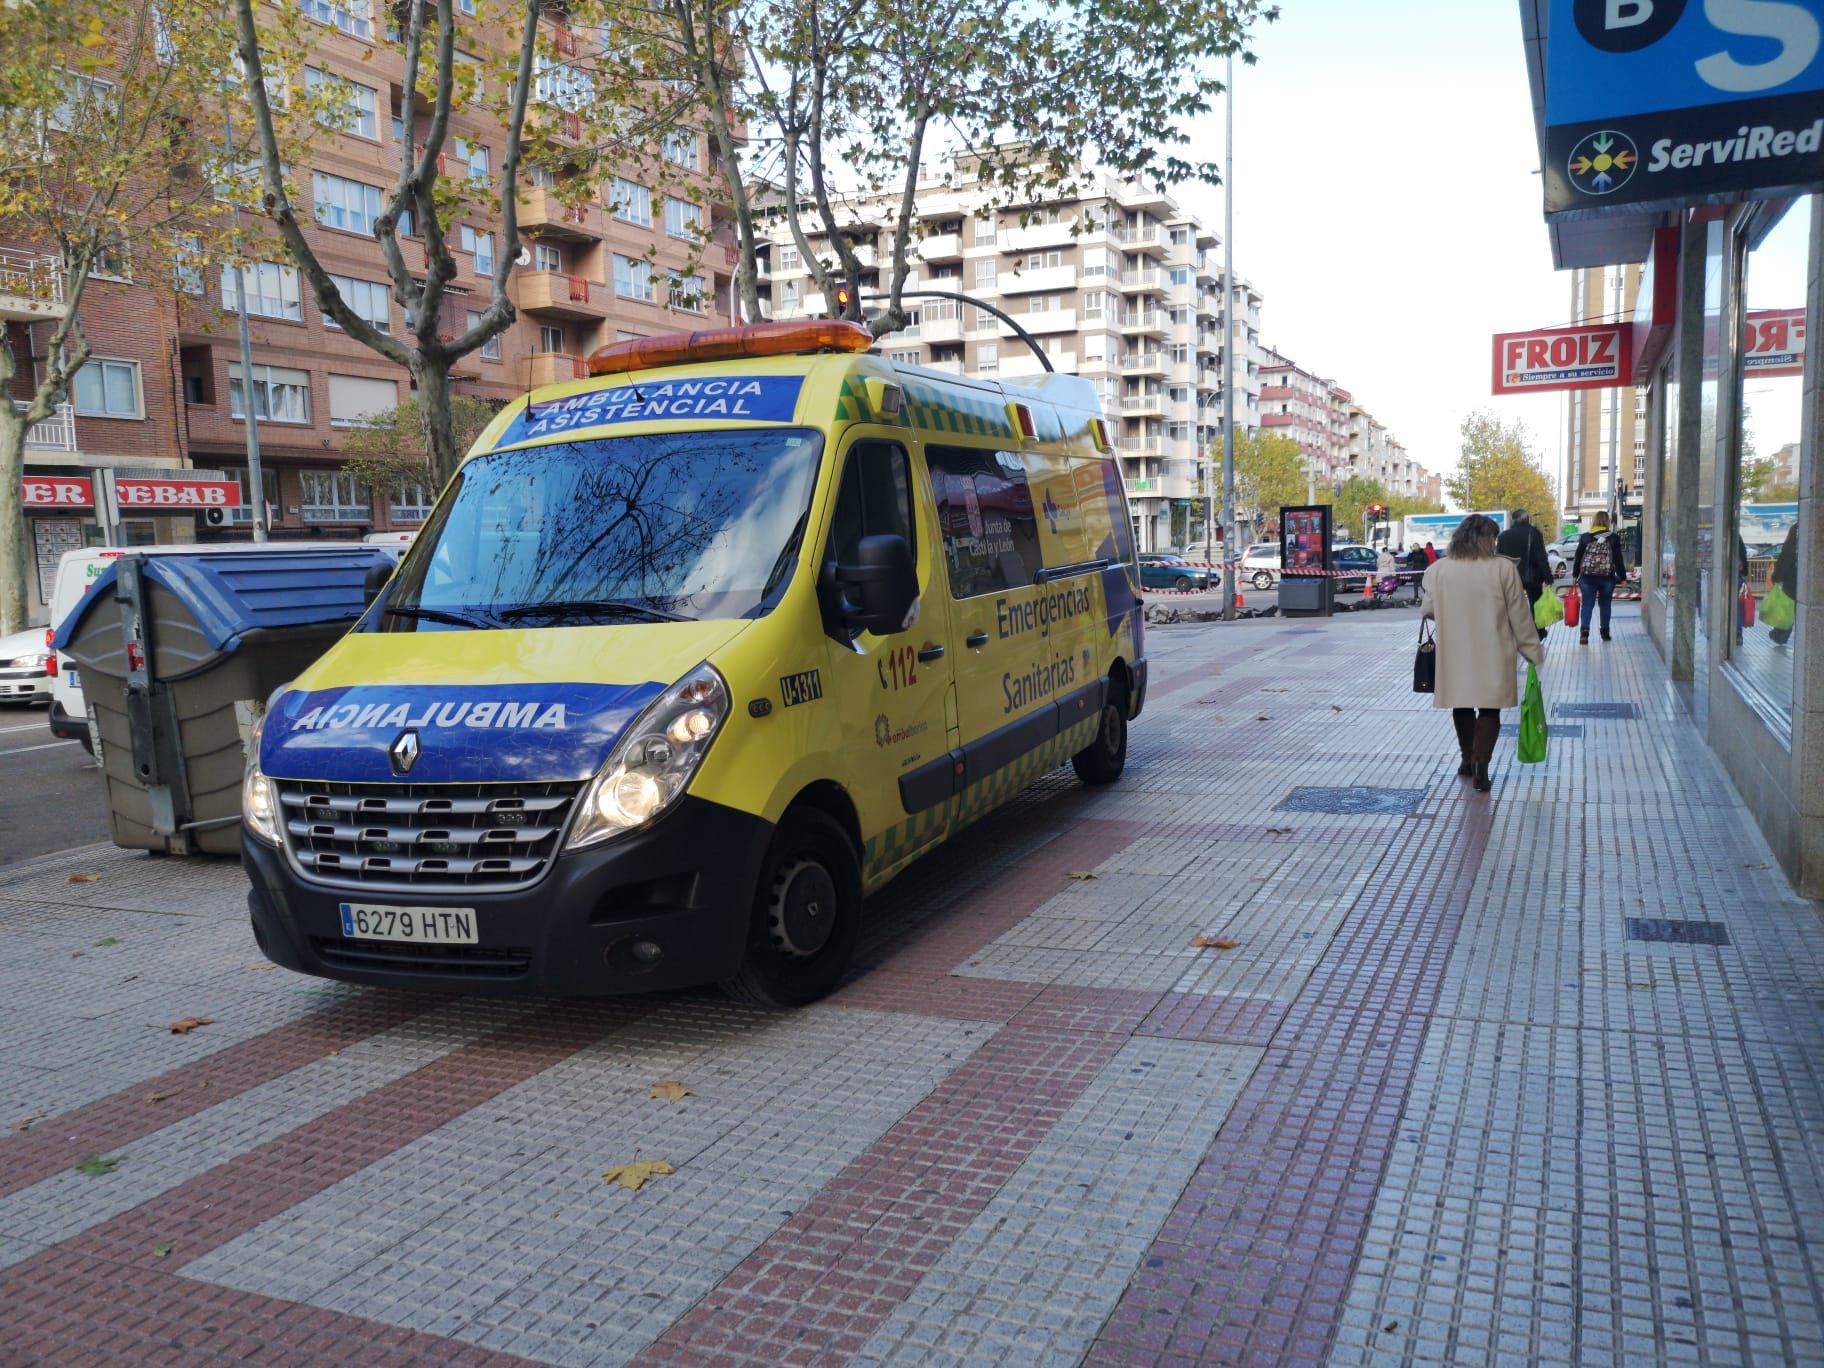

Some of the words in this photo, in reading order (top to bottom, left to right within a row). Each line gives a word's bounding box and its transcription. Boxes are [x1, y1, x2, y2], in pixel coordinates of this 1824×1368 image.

[1648, 119, 1824, 172] ServiRed
[1507, 333, 1616, 370] FROIZ
[1522, 372, 1557, 381] Siempre
[1580, 367, 1614, 376] servicio
[528, 398, 751, 435] ASISTENCIAL
[540, 381, 762, 417] AMBULANCIA
[23, 484, 86, 504] ER
[985, 519, 1003, 535] Junta
[1003, 517, 1012, 534] de
[996, 582, 1090, 639] Emergencias
[889, 645, 917, 691] 112
[1003, 652, 1075, 714] Sanitarias
[781, 671, 821, 706] U-1311
[356, 909, 414, 937] 6279
[422, 912, 471, 939] HTN
